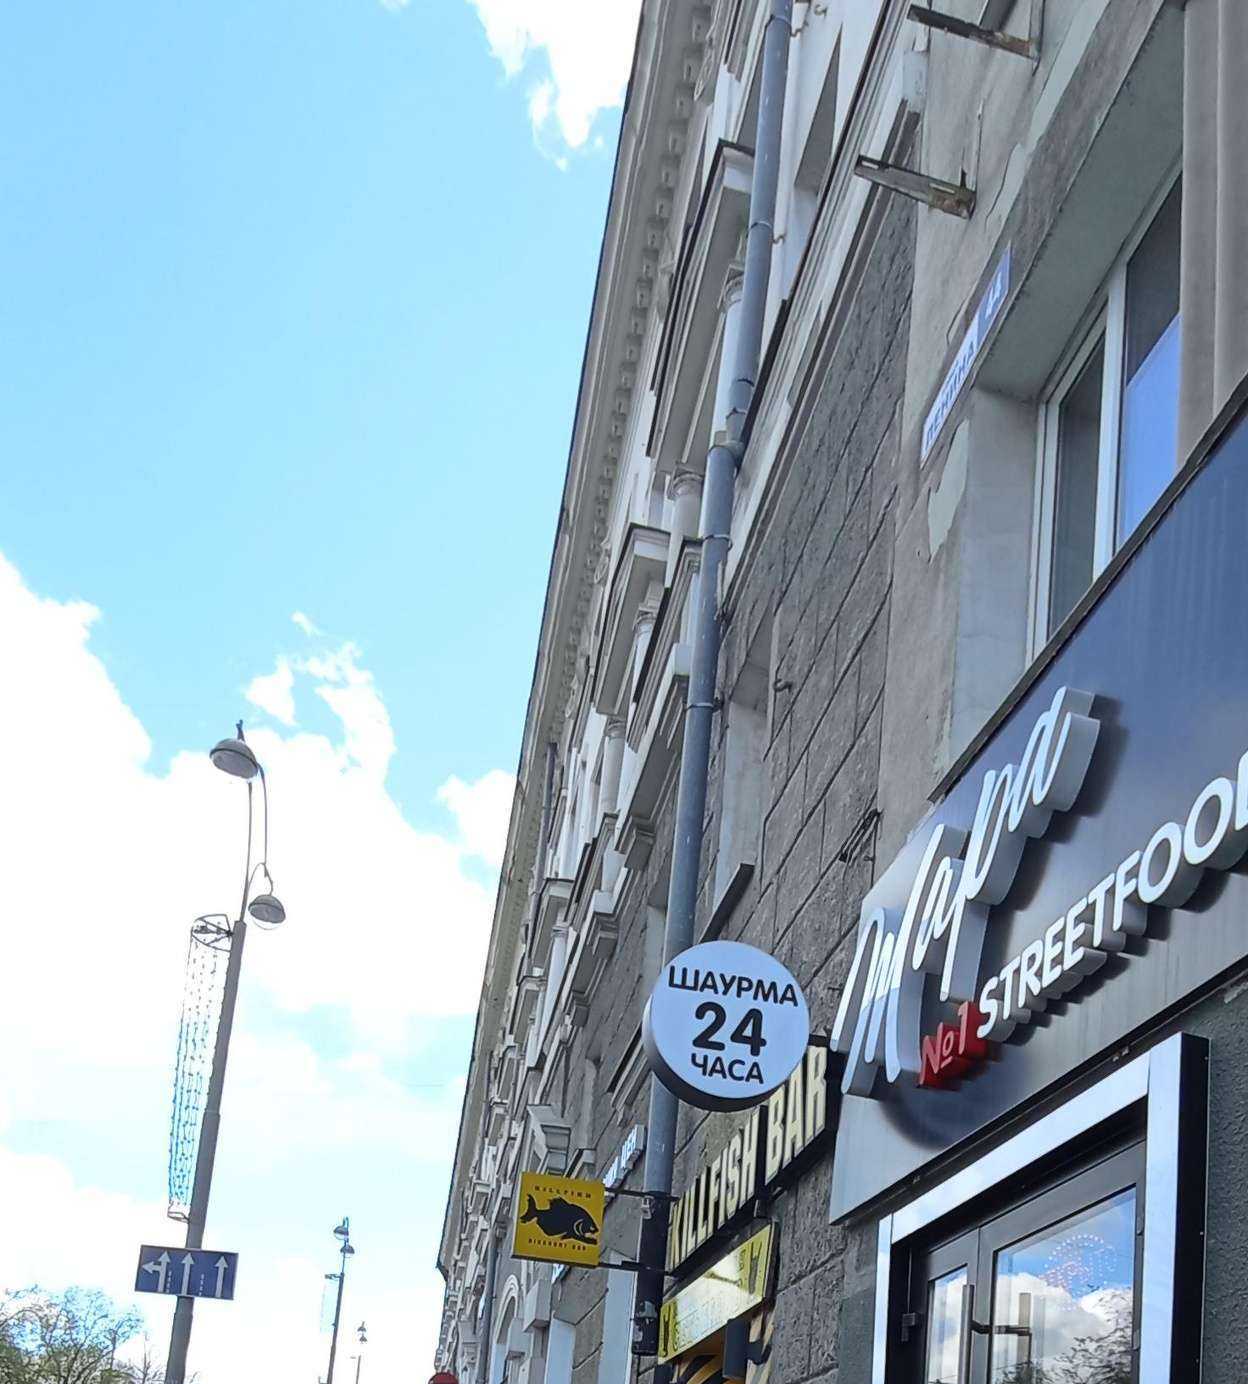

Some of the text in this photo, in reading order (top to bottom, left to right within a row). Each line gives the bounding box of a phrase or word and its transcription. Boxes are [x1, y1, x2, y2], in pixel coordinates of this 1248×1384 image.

[977, 750, 1248, 1039] STREETFOO
[668, 965, 798, 1007] ШАУРМА
[692, 1001, 767, 1057] 24
[691, 1053, 764, 1084] ЧАСА
[664, 1104, 761, 1273] KILLFISH
[765, 1046, 828, 1186] BAR
